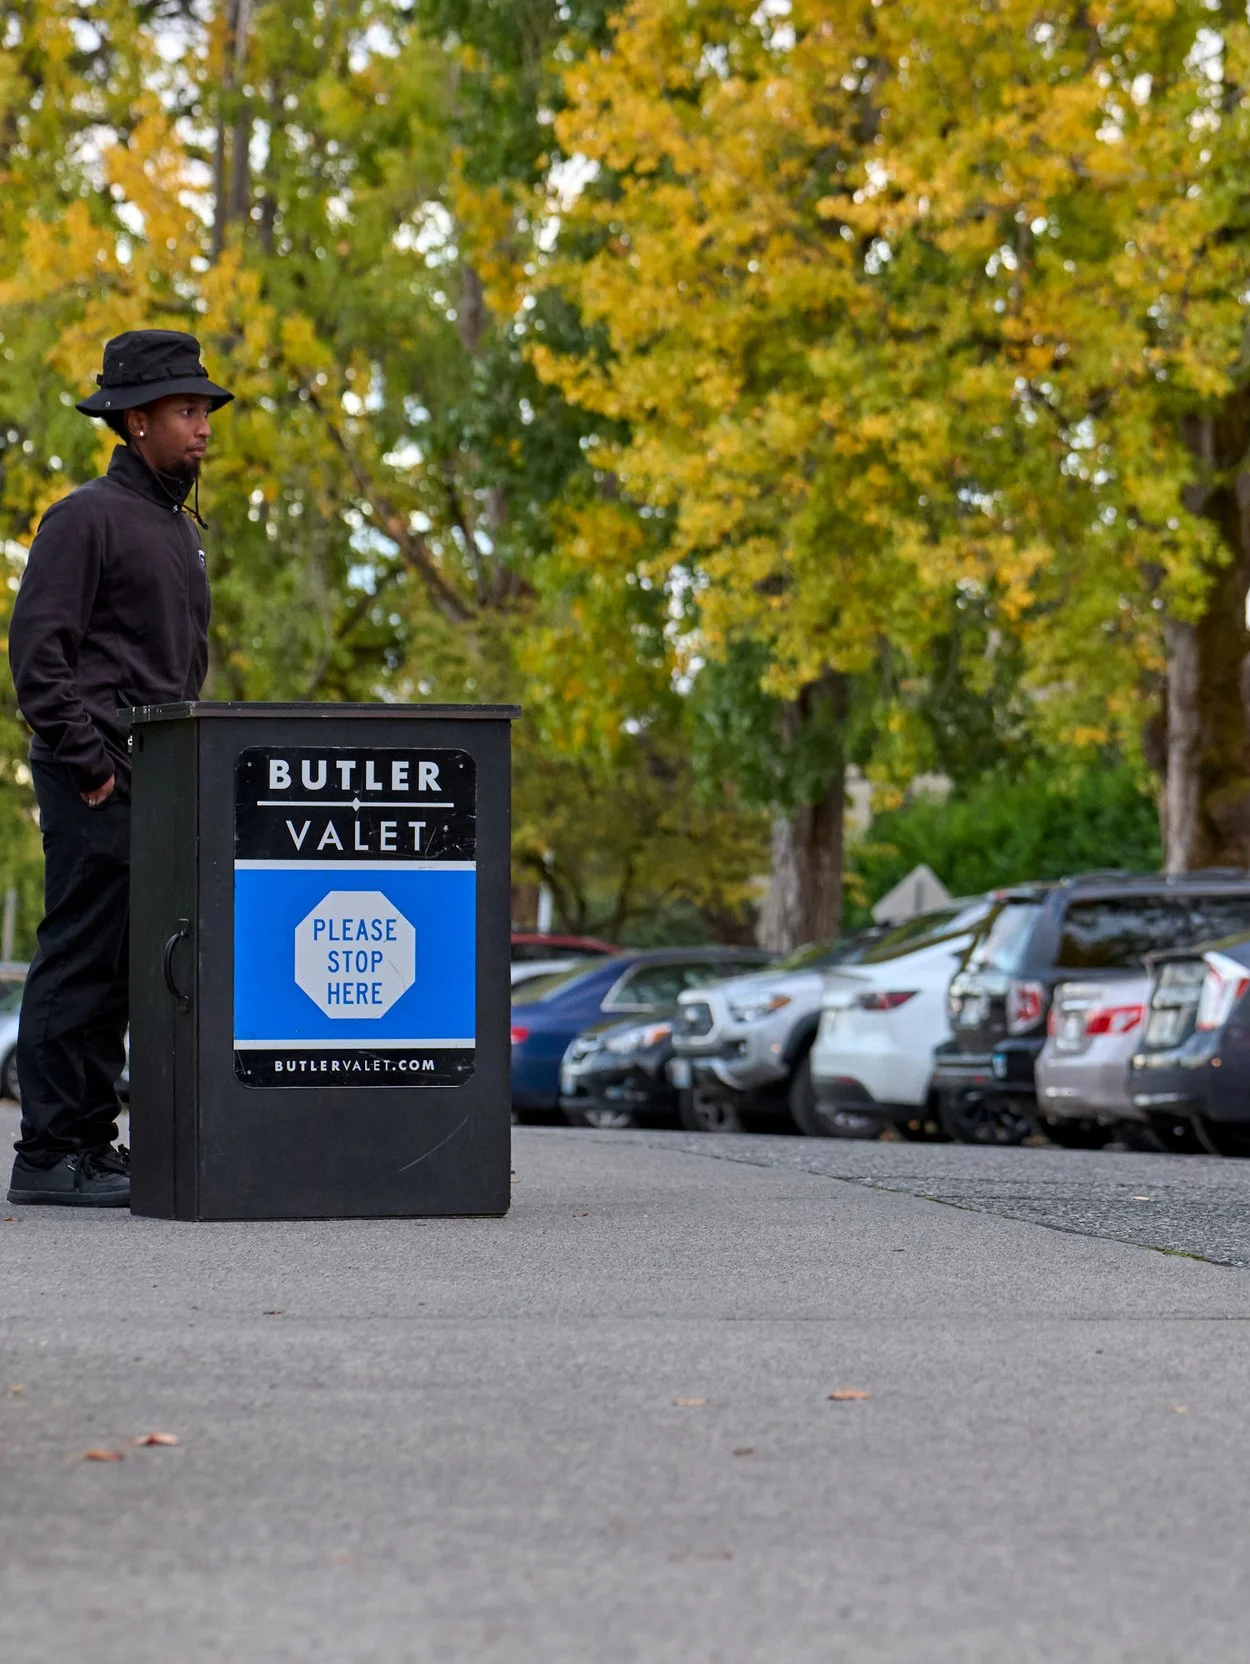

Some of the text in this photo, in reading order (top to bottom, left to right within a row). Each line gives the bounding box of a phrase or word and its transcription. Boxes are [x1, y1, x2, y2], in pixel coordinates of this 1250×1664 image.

[269, 759, 442, 791] BUTLER
[286, 820, 427, 851] VALET
[313, 919, 397, 941] PLEASE
[327, 951, 383, 973] STOP
[327, 982, 383, 1005] HERE
[274, 1059, 435, 1072] BUTLERVALET.COM
